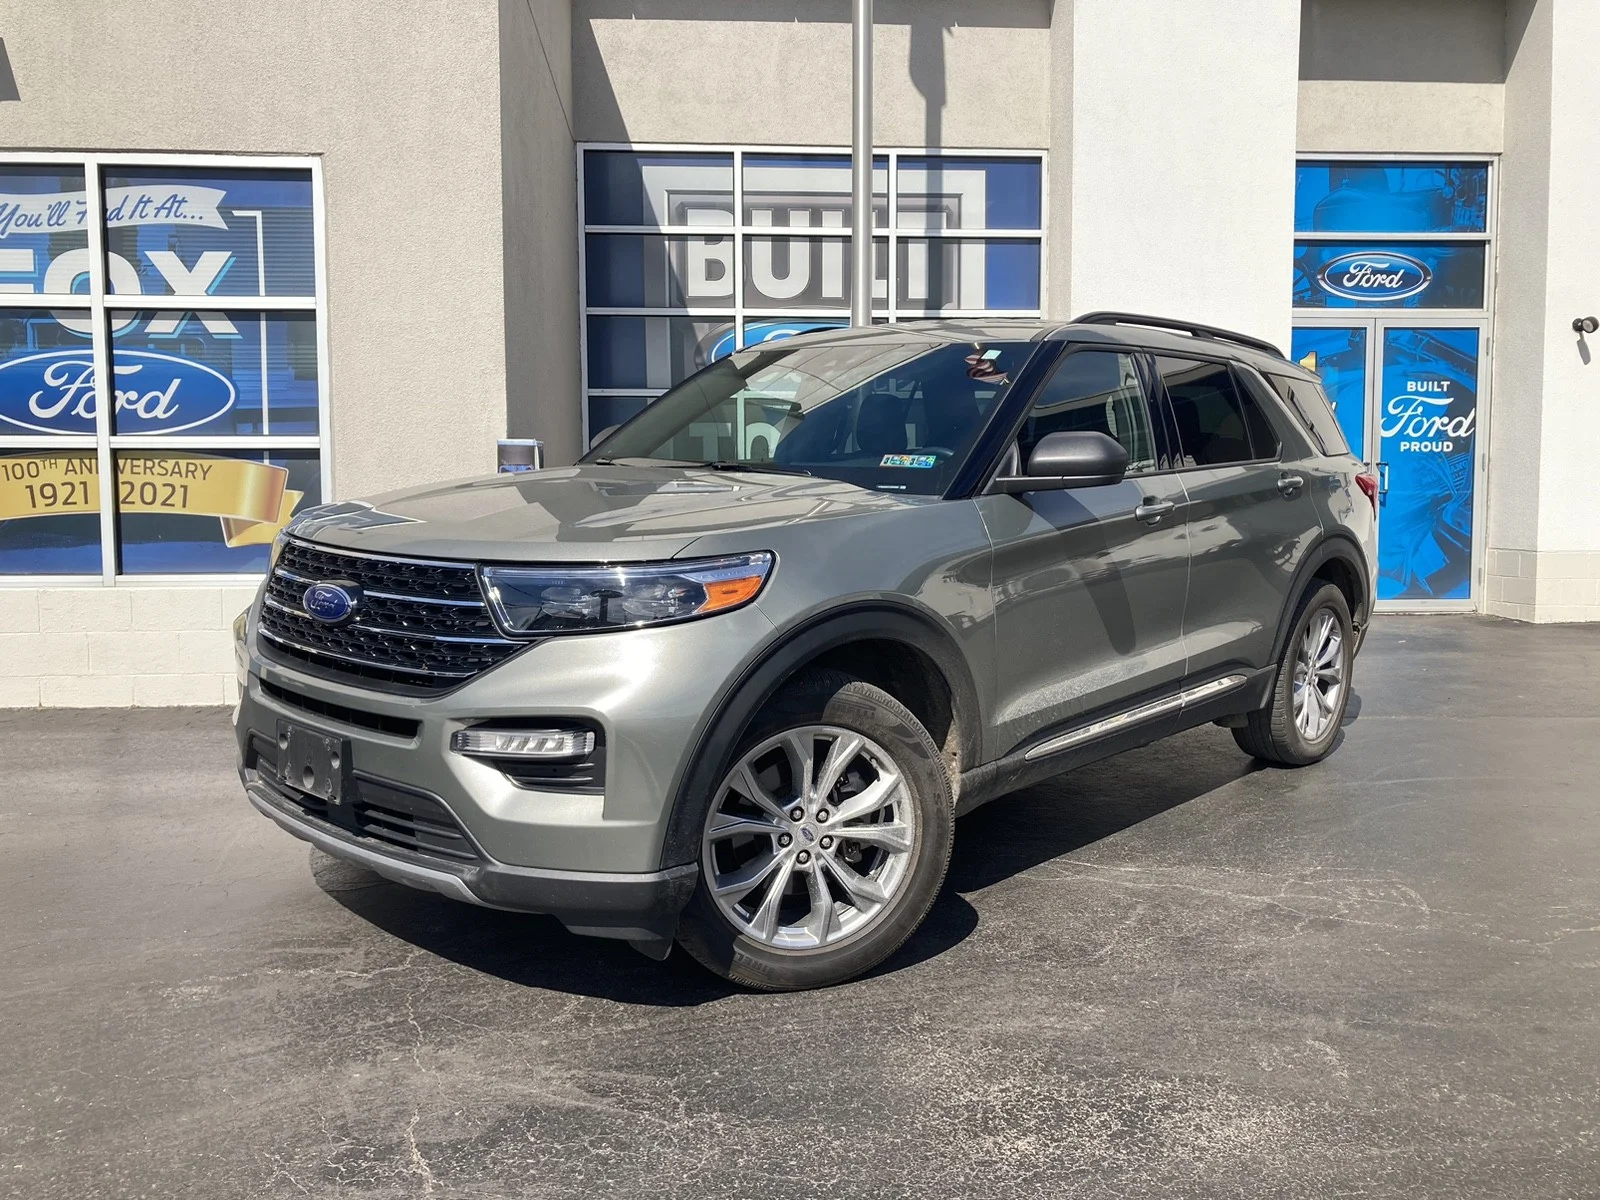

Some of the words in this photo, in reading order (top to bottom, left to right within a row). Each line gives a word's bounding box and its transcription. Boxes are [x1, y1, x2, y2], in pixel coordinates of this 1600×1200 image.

[0, 200, 71, 235] You'll
[129, 194, 152, 219] It
[154, 193, 203, 220] At...
[1342, 261, 1405, 288] Ford
[29, 360, 181, 419] Ford
[1406, 381, 1450, 392] BUILT
[1380, 395, 1475, 438] Ford
[1400, 441, 1453, 452] PROUD
[1, 459, 58, 481] 100TH
[64, 457, 213, 481] ANVERSARY
[25, 481, 89, 508] 1921
[120, 481, 189, 508] 2021
